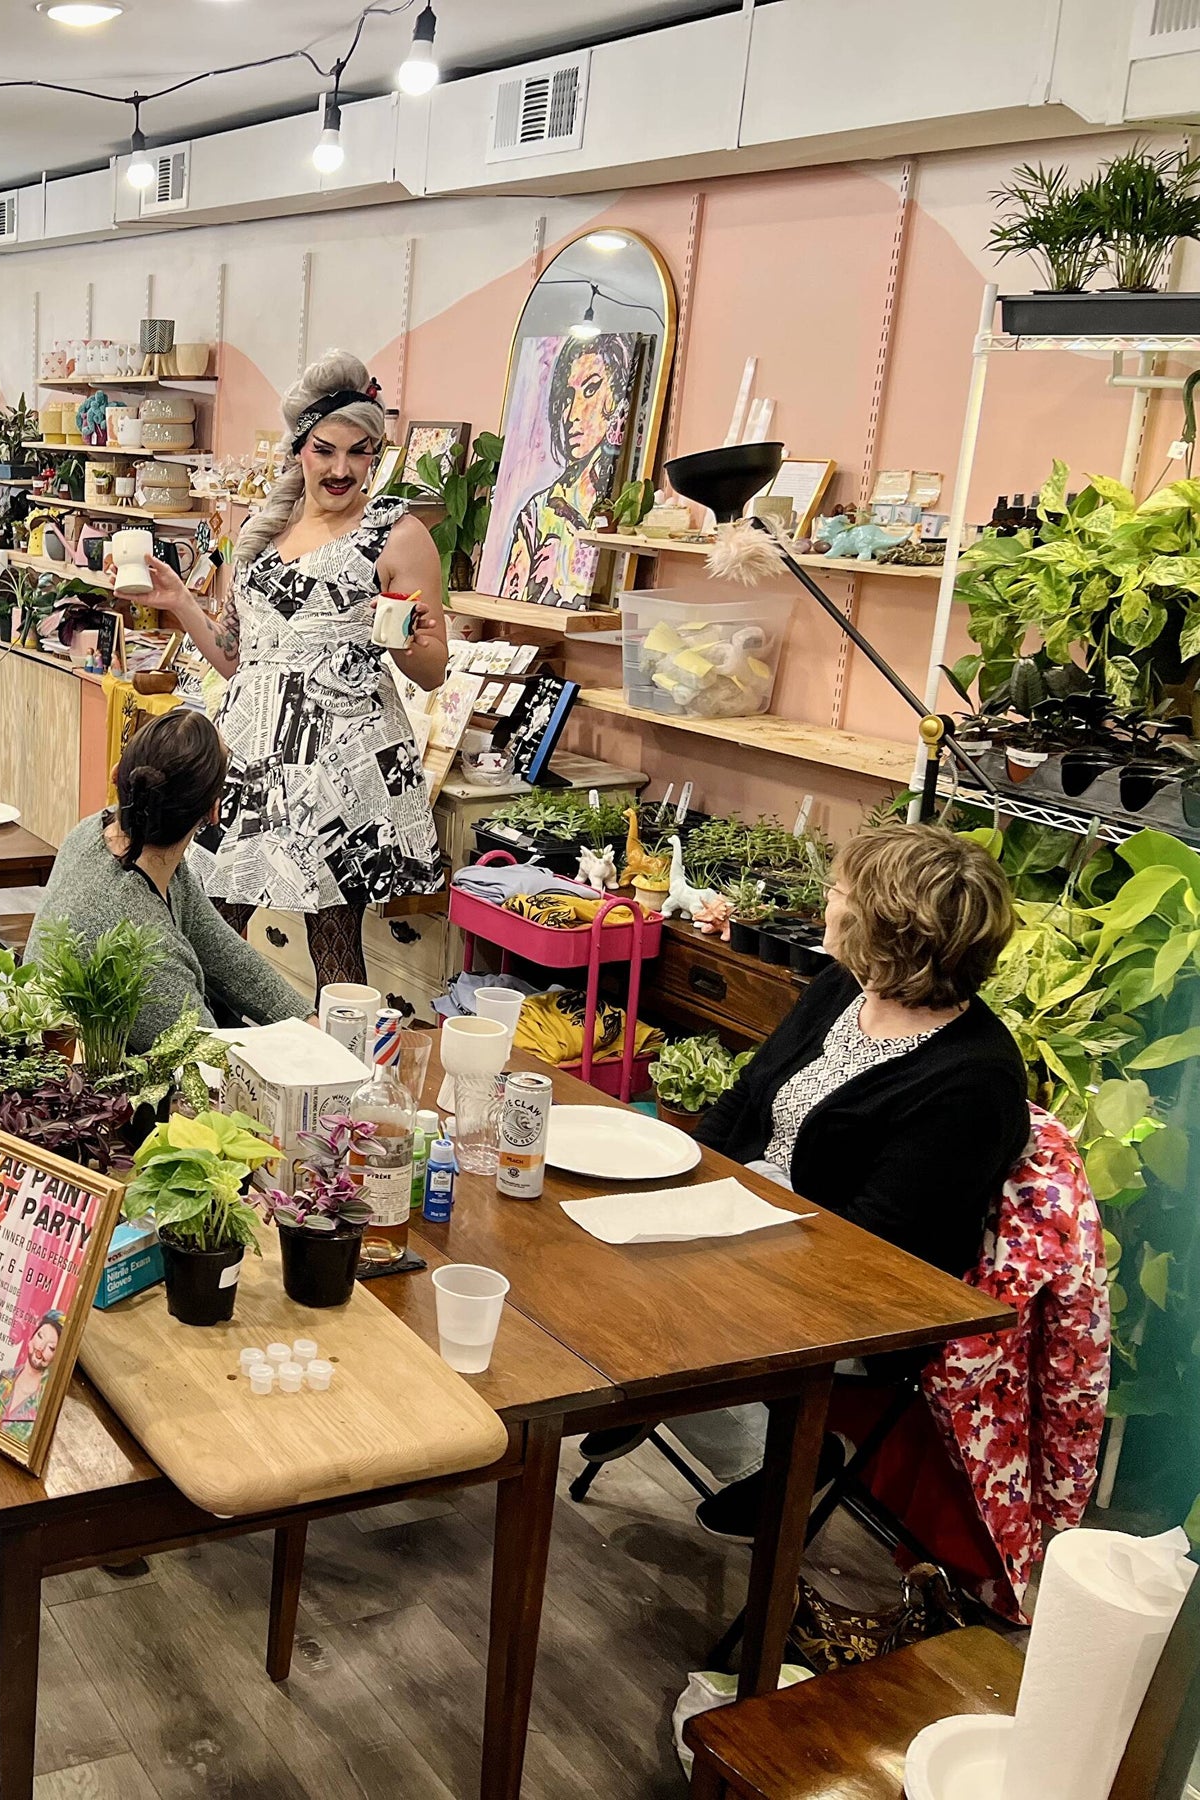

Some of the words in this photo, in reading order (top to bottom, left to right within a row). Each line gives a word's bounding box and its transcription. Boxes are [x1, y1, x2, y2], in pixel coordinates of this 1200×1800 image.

[347, 1032, 362, 1053] HITE
[235, 1065, 258, 1101] CLAW
[514, 1099, 542, 1117] CLAW
[506, 1156, 524, 1164] PEACH
[31, 1169, 93, 1213] PAINT
[20, 1197, 93, 1250] PARTY
[1, 1226, 25, 1248] INNER
[25, 1240, 47, 1260] DRAG
[7, 1258, 17, 1274] 6
[25, 1267, 34, 1283] 8
[35, 1272, 53, 1293] PM
[107, 1266, 129, 1282] Nitrile
[130, 1256, 151, 1272] Exam
[107, 1275, 132, 1292] Gloves
